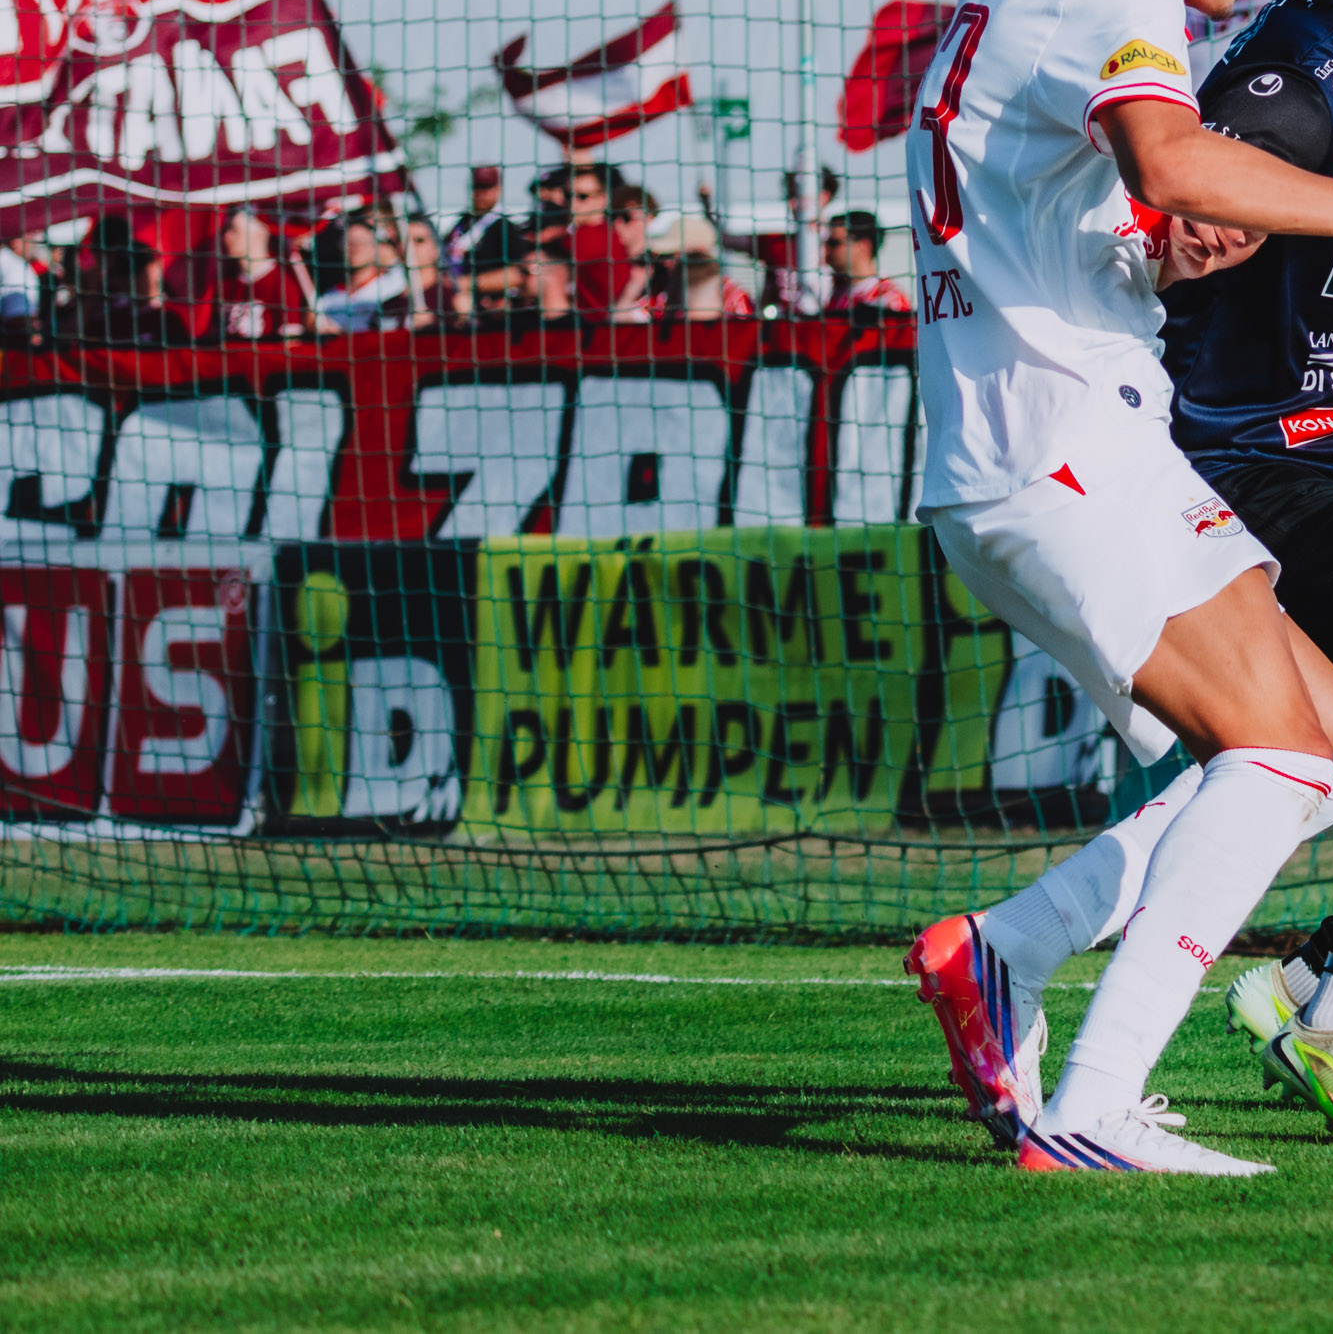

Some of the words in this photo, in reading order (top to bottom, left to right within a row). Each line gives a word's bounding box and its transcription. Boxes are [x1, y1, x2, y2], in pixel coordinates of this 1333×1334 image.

[1119, 46, 1179, 72] RAUCH
[911, 2, 990, 247] 3
[1301, 369, 1324, 392] DI
[506, 537, 894, 673] WÄRME
[494, 695, 884, 815] PUMPEN
